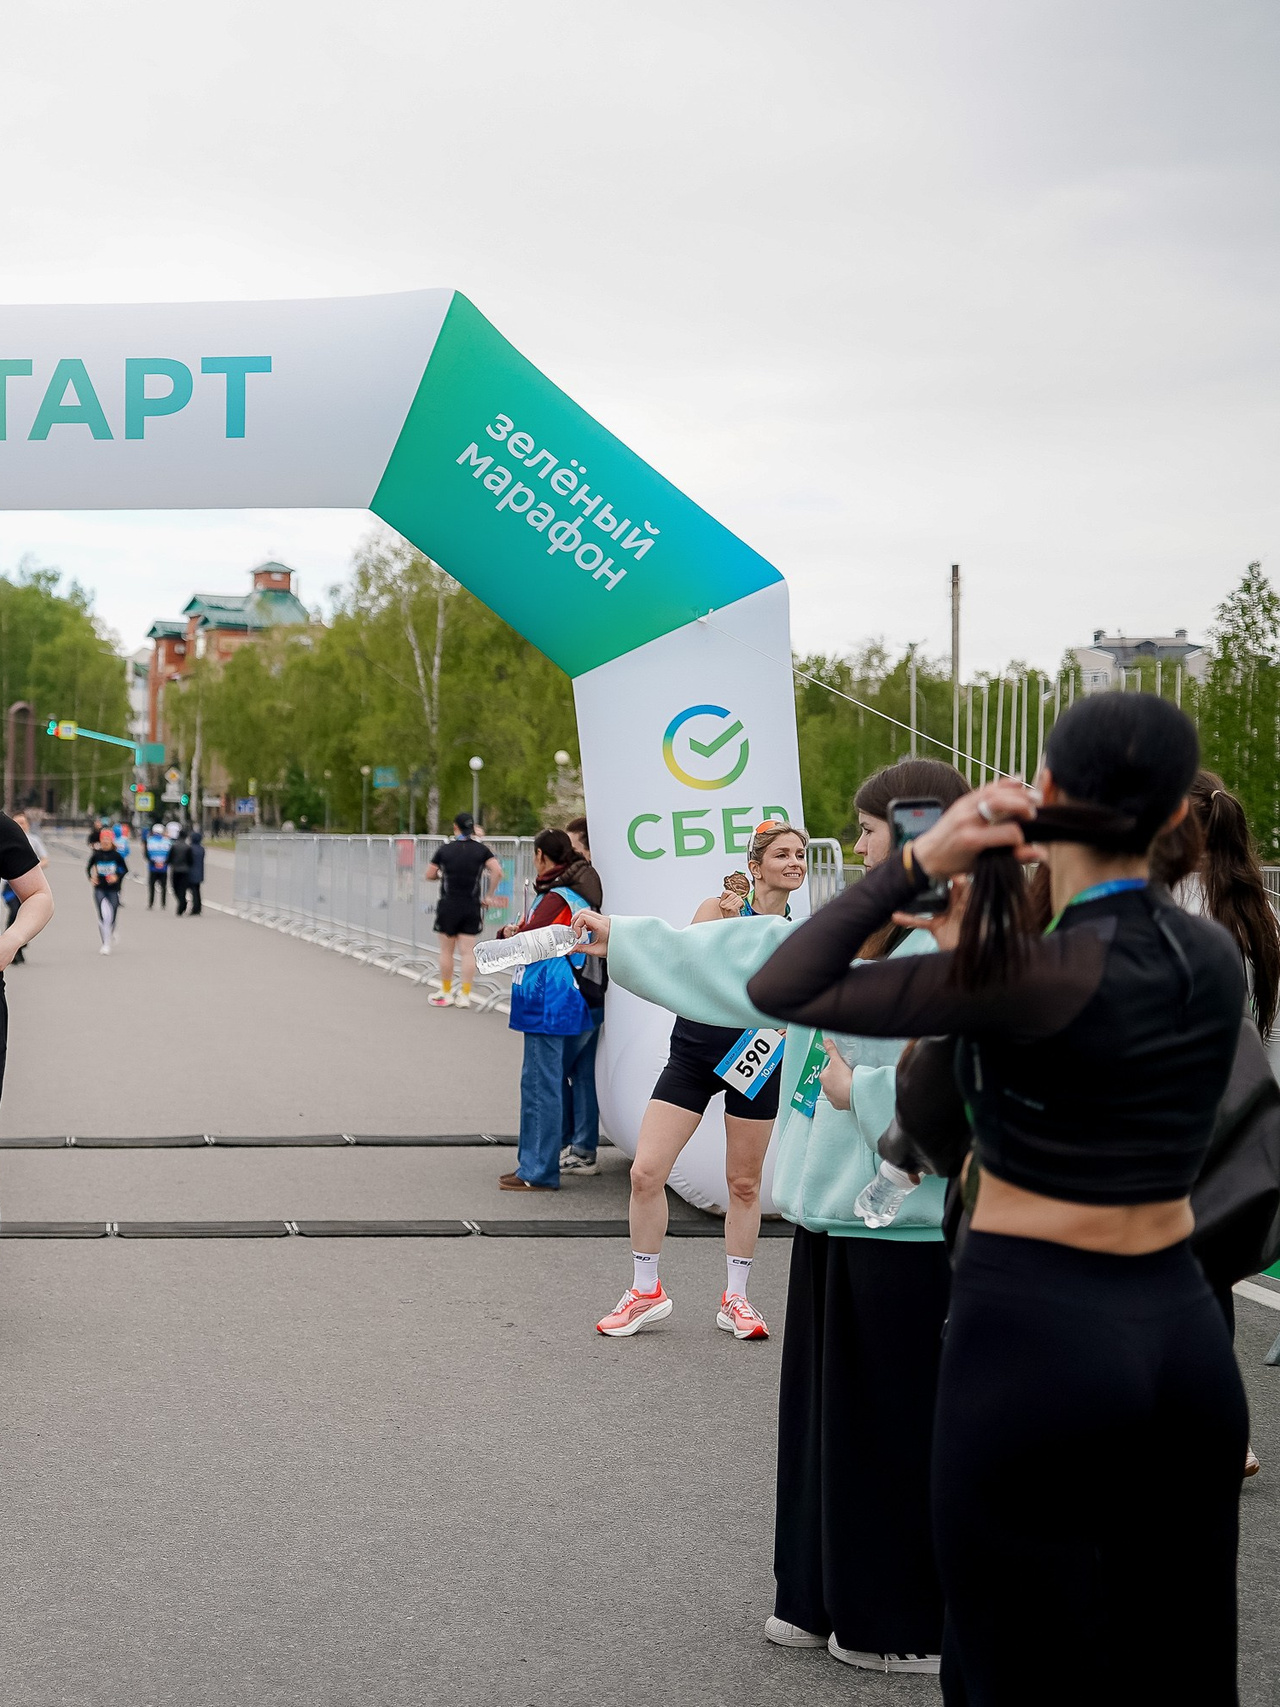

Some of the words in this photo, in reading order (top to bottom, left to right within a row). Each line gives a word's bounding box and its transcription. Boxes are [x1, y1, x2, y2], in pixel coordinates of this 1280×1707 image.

[455, 441, 628, 592] марафон
[485, 412, 661, 561] зелёный
[734, 1038, 771, 1078] 590
